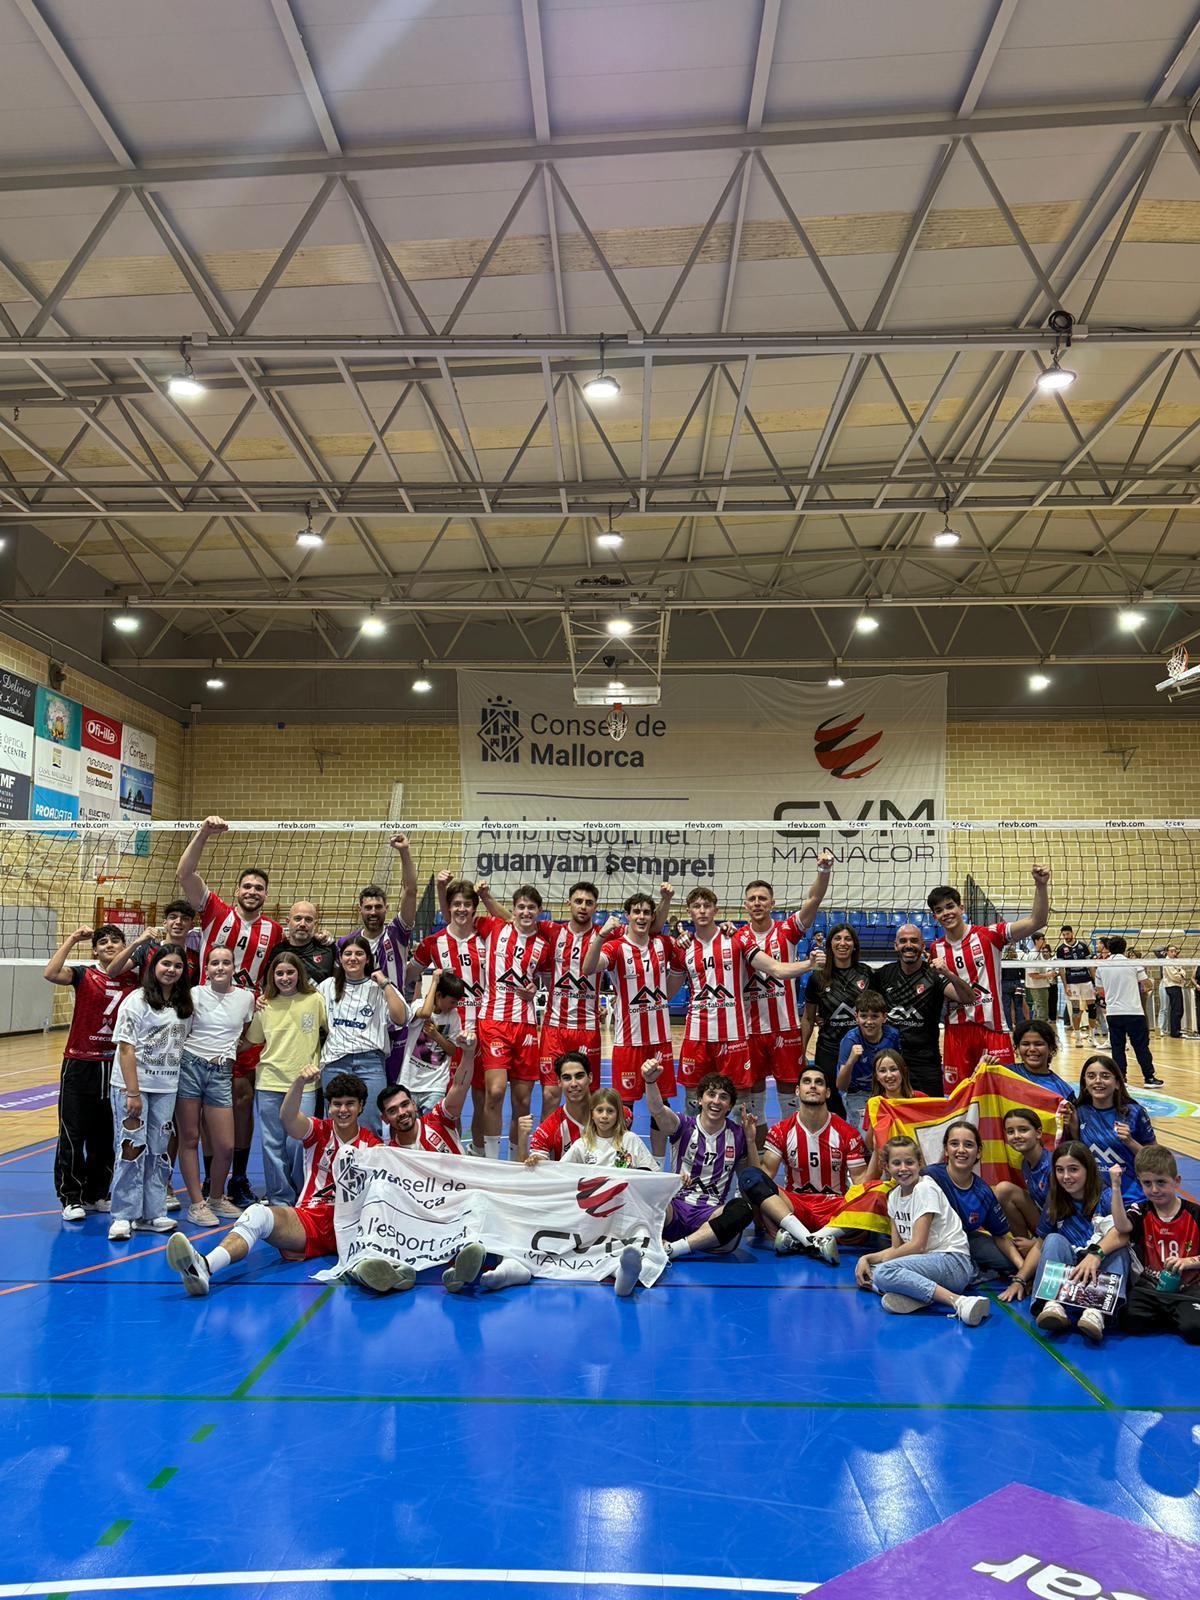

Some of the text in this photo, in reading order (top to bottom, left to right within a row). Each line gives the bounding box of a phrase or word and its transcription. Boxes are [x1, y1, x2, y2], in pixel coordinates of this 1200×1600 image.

[88, 722, 115, 742] Ofi-illa
[635, 713, 666, 737] de
[530, 743, 644, 768] Mallorca
[773, 799, 935, 838] CVM
[772, 845, 935, 864] MANACOR
[476, 852, 716, 882] guanyam sempre!
[237, 936, 247, 950] 4
[458, 954, 473, 966] 15
[514, 945, 525, 960] 12
[572, 947, 580, 960] 2
[643, 960, 651, 972] 7
[702, 956, 716, 971] 14
[954, 955, 965, 969] 8
[102, 989, 123, 1016] 7
[703, 1151, 717, 1166] 17
[809, 1152, 819, 1168] 5
[442, 1179, 467, 1192] de
[367, 1217, 436, 1252] l'esport
[1157, 1239, 1179, 1263] 18
